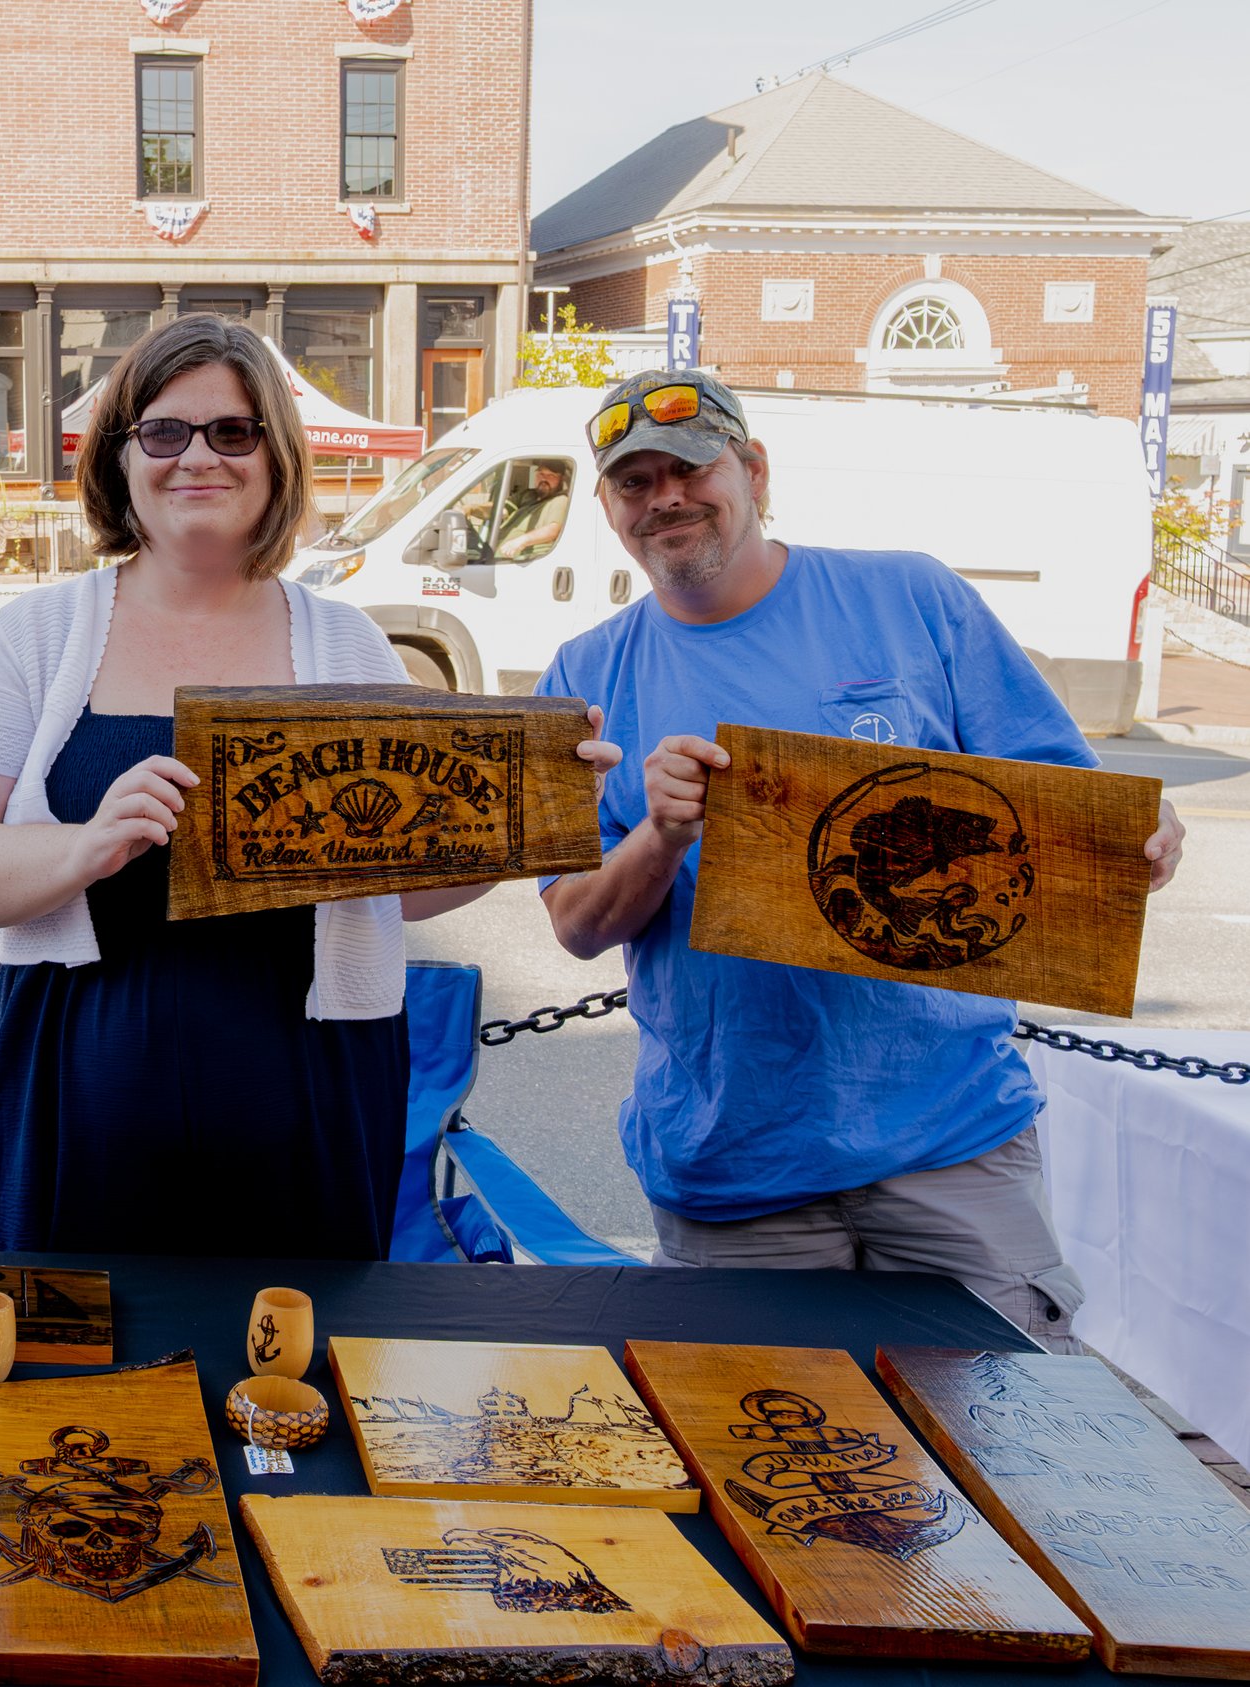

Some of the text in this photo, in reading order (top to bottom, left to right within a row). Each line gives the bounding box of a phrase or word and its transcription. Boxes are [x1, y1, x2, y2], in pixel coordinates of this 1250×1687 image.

[1144, 310, 1171, 495] 55 MAIN
[231, 736, 505, 824] BEACH HOUSE
[967, 1402, 1150, 1450] CAMP
[839, 1447, 882, 1465] me
[1054, 1470, 1174, 1498] MORE
[777, 1497, 830, 1525] and
[825, 1493, 876, 1513] the
[1117, 1555, 1250, 1592] LESS
